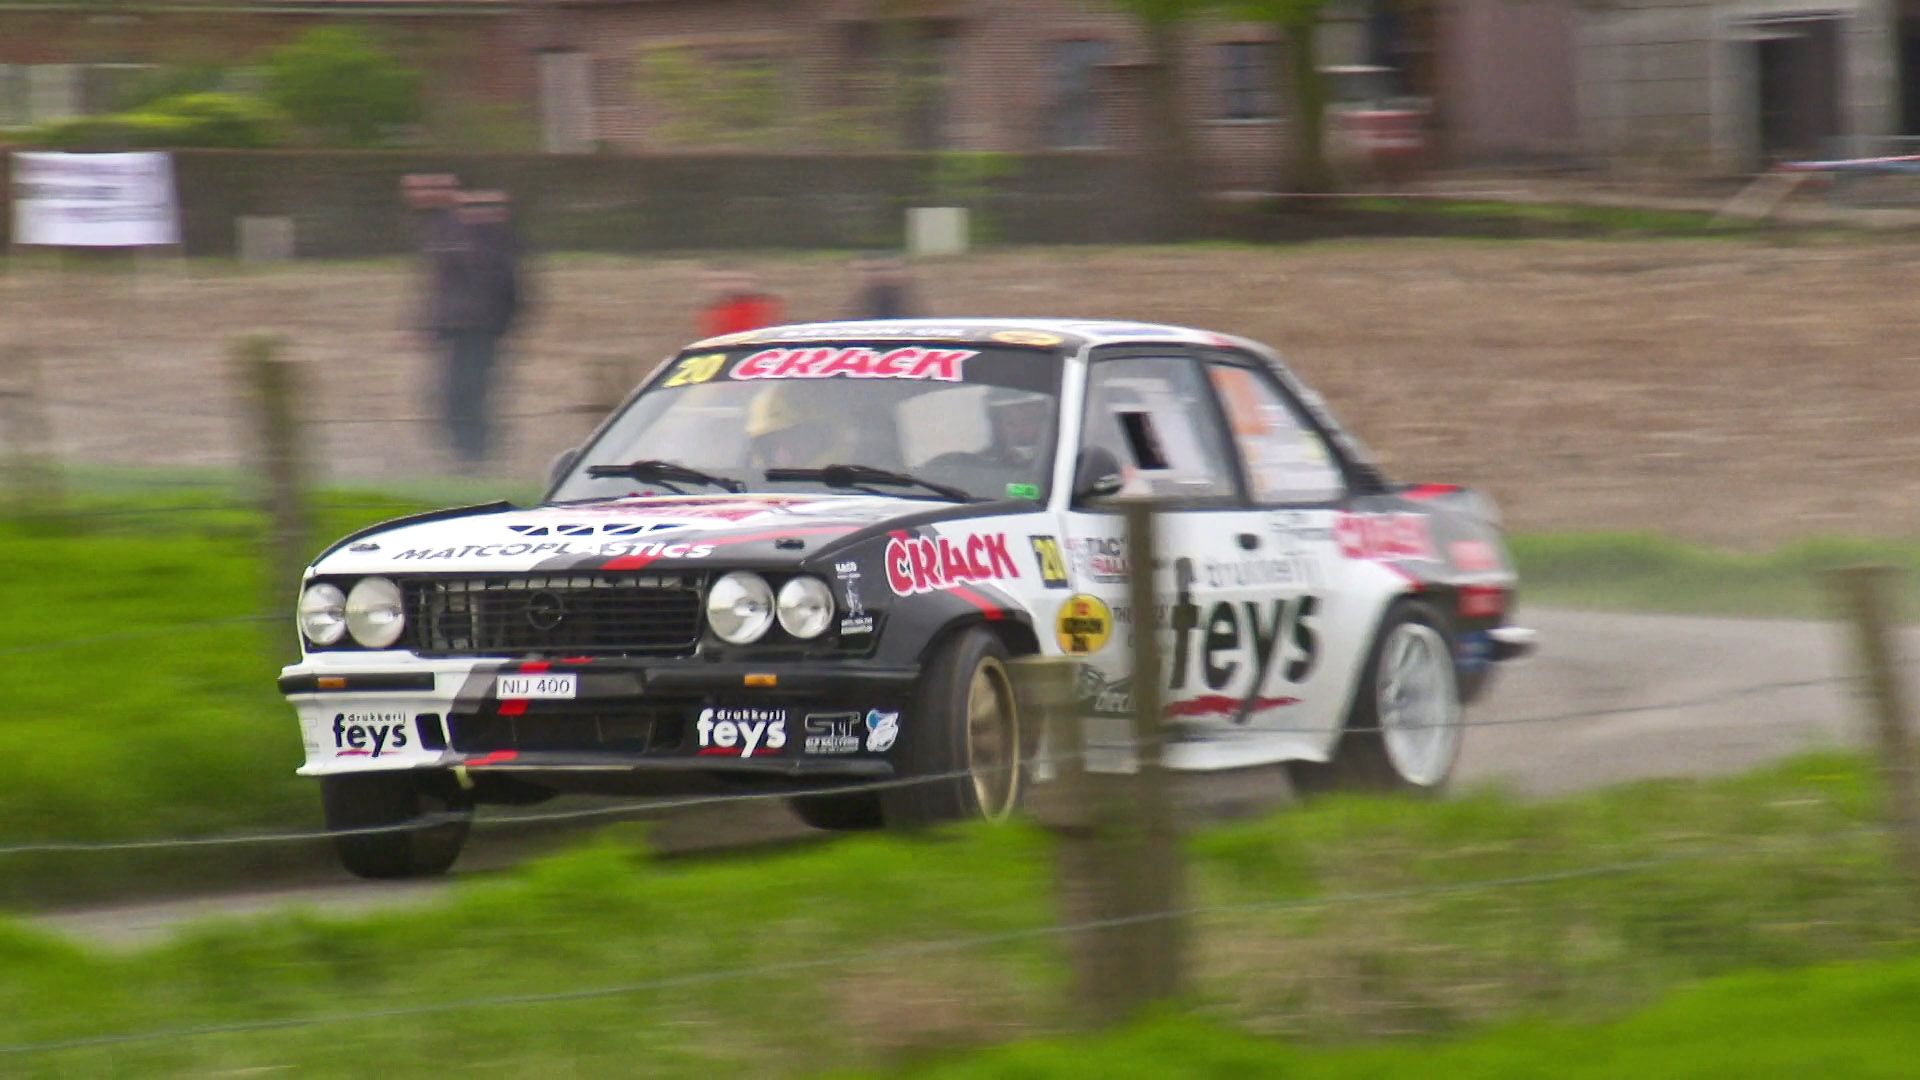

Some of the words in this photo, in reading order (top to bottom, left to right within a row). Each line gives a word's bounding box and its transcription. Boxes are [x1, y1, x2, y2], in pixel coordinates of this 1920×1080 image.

[663, 354, 726, 387] 20
[729, 347, 981, 382] CRACK
[393, 542, 716, 560] MATCOPLASTICS
[885, 531, 1020, 596] CRACK
[1168, 556, 1321, 725] feys
[502, 679, 529, 694] NIJ
[536, 678, 570, 693] 400
[332, 713, 407, 757] feys
[348, 713, 406, 725] drukkerij
[697, 708, 786, 758] feys
[717, 709, 786, 727] drukkerij
